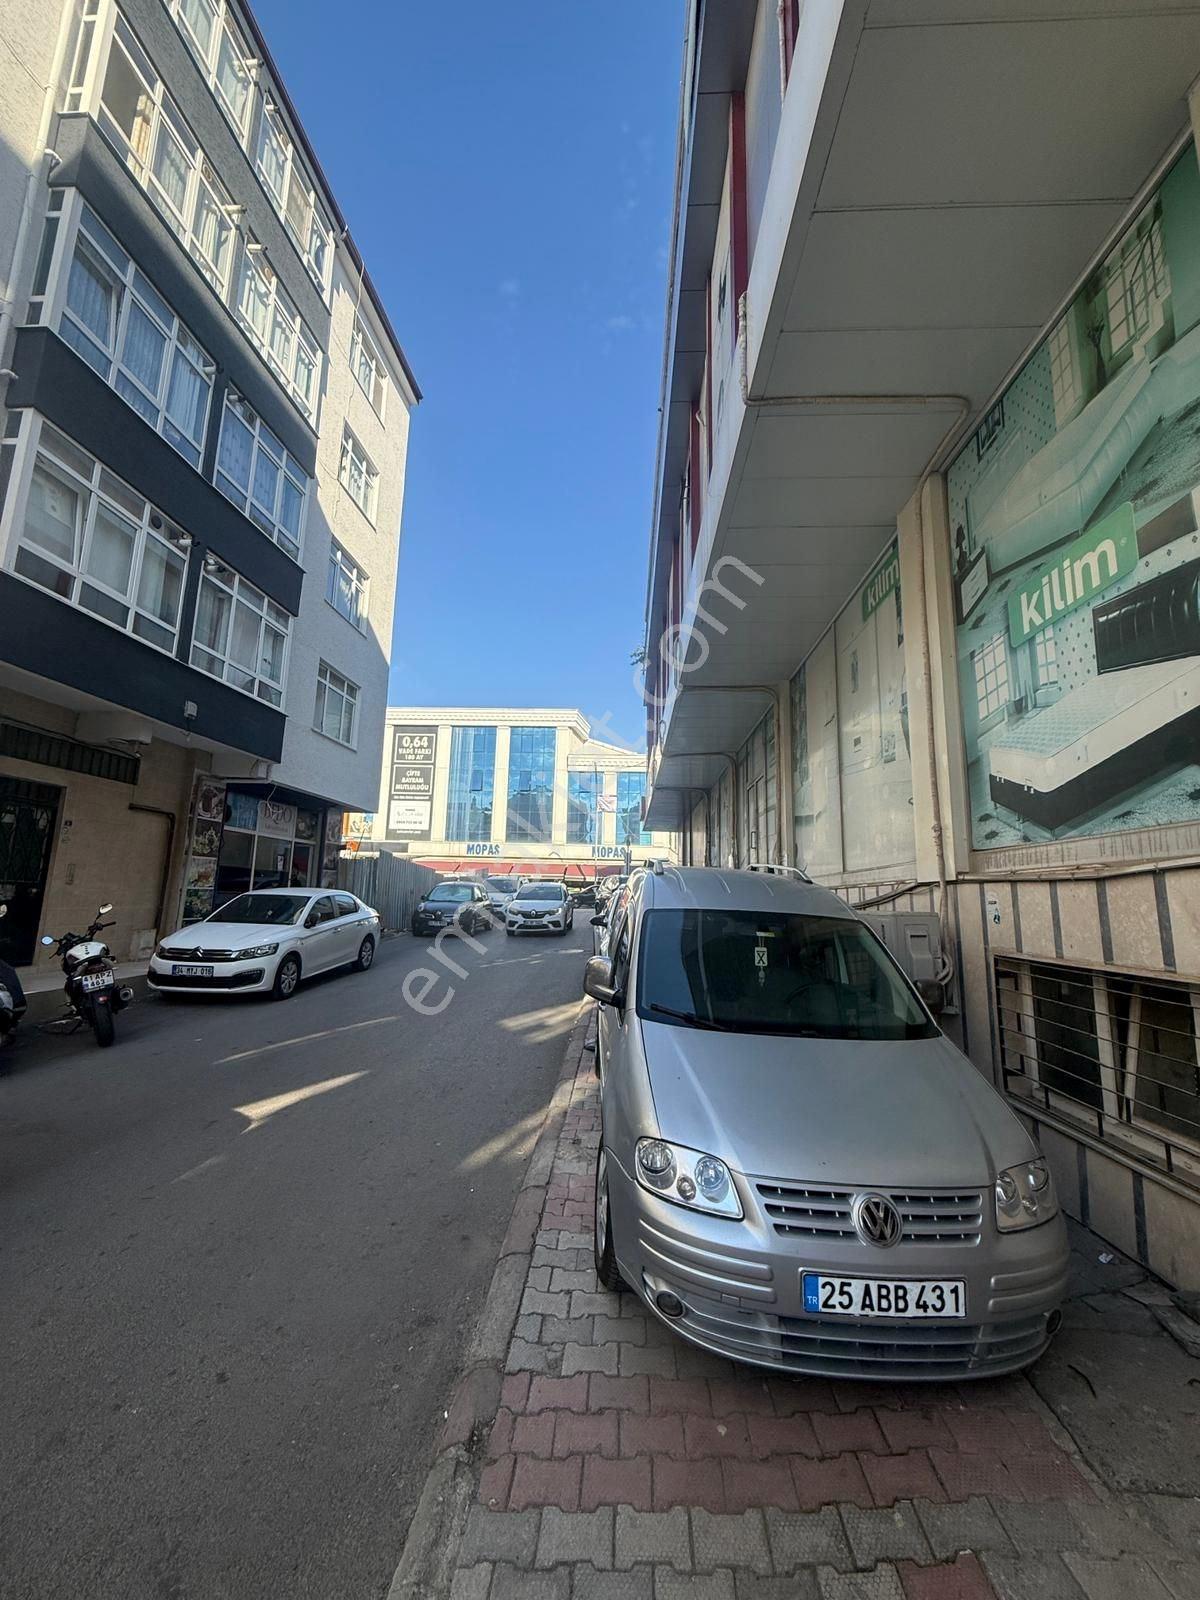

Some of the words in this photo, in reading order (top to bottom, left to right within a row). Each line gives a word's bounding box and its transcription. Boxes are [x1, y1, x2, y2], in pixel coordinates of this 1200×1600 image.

[867, 558, 899, 612] kilim
[1020, 539, 1118, 635] kilim
[402, 735, 429, 748] 0,64
[806, 1294, 818, 1305] TR
[820, 1281, 854, 1310] 25
[860, 1283, 909, 1312] ABB
[915, 1284, 962, 1313] 431
